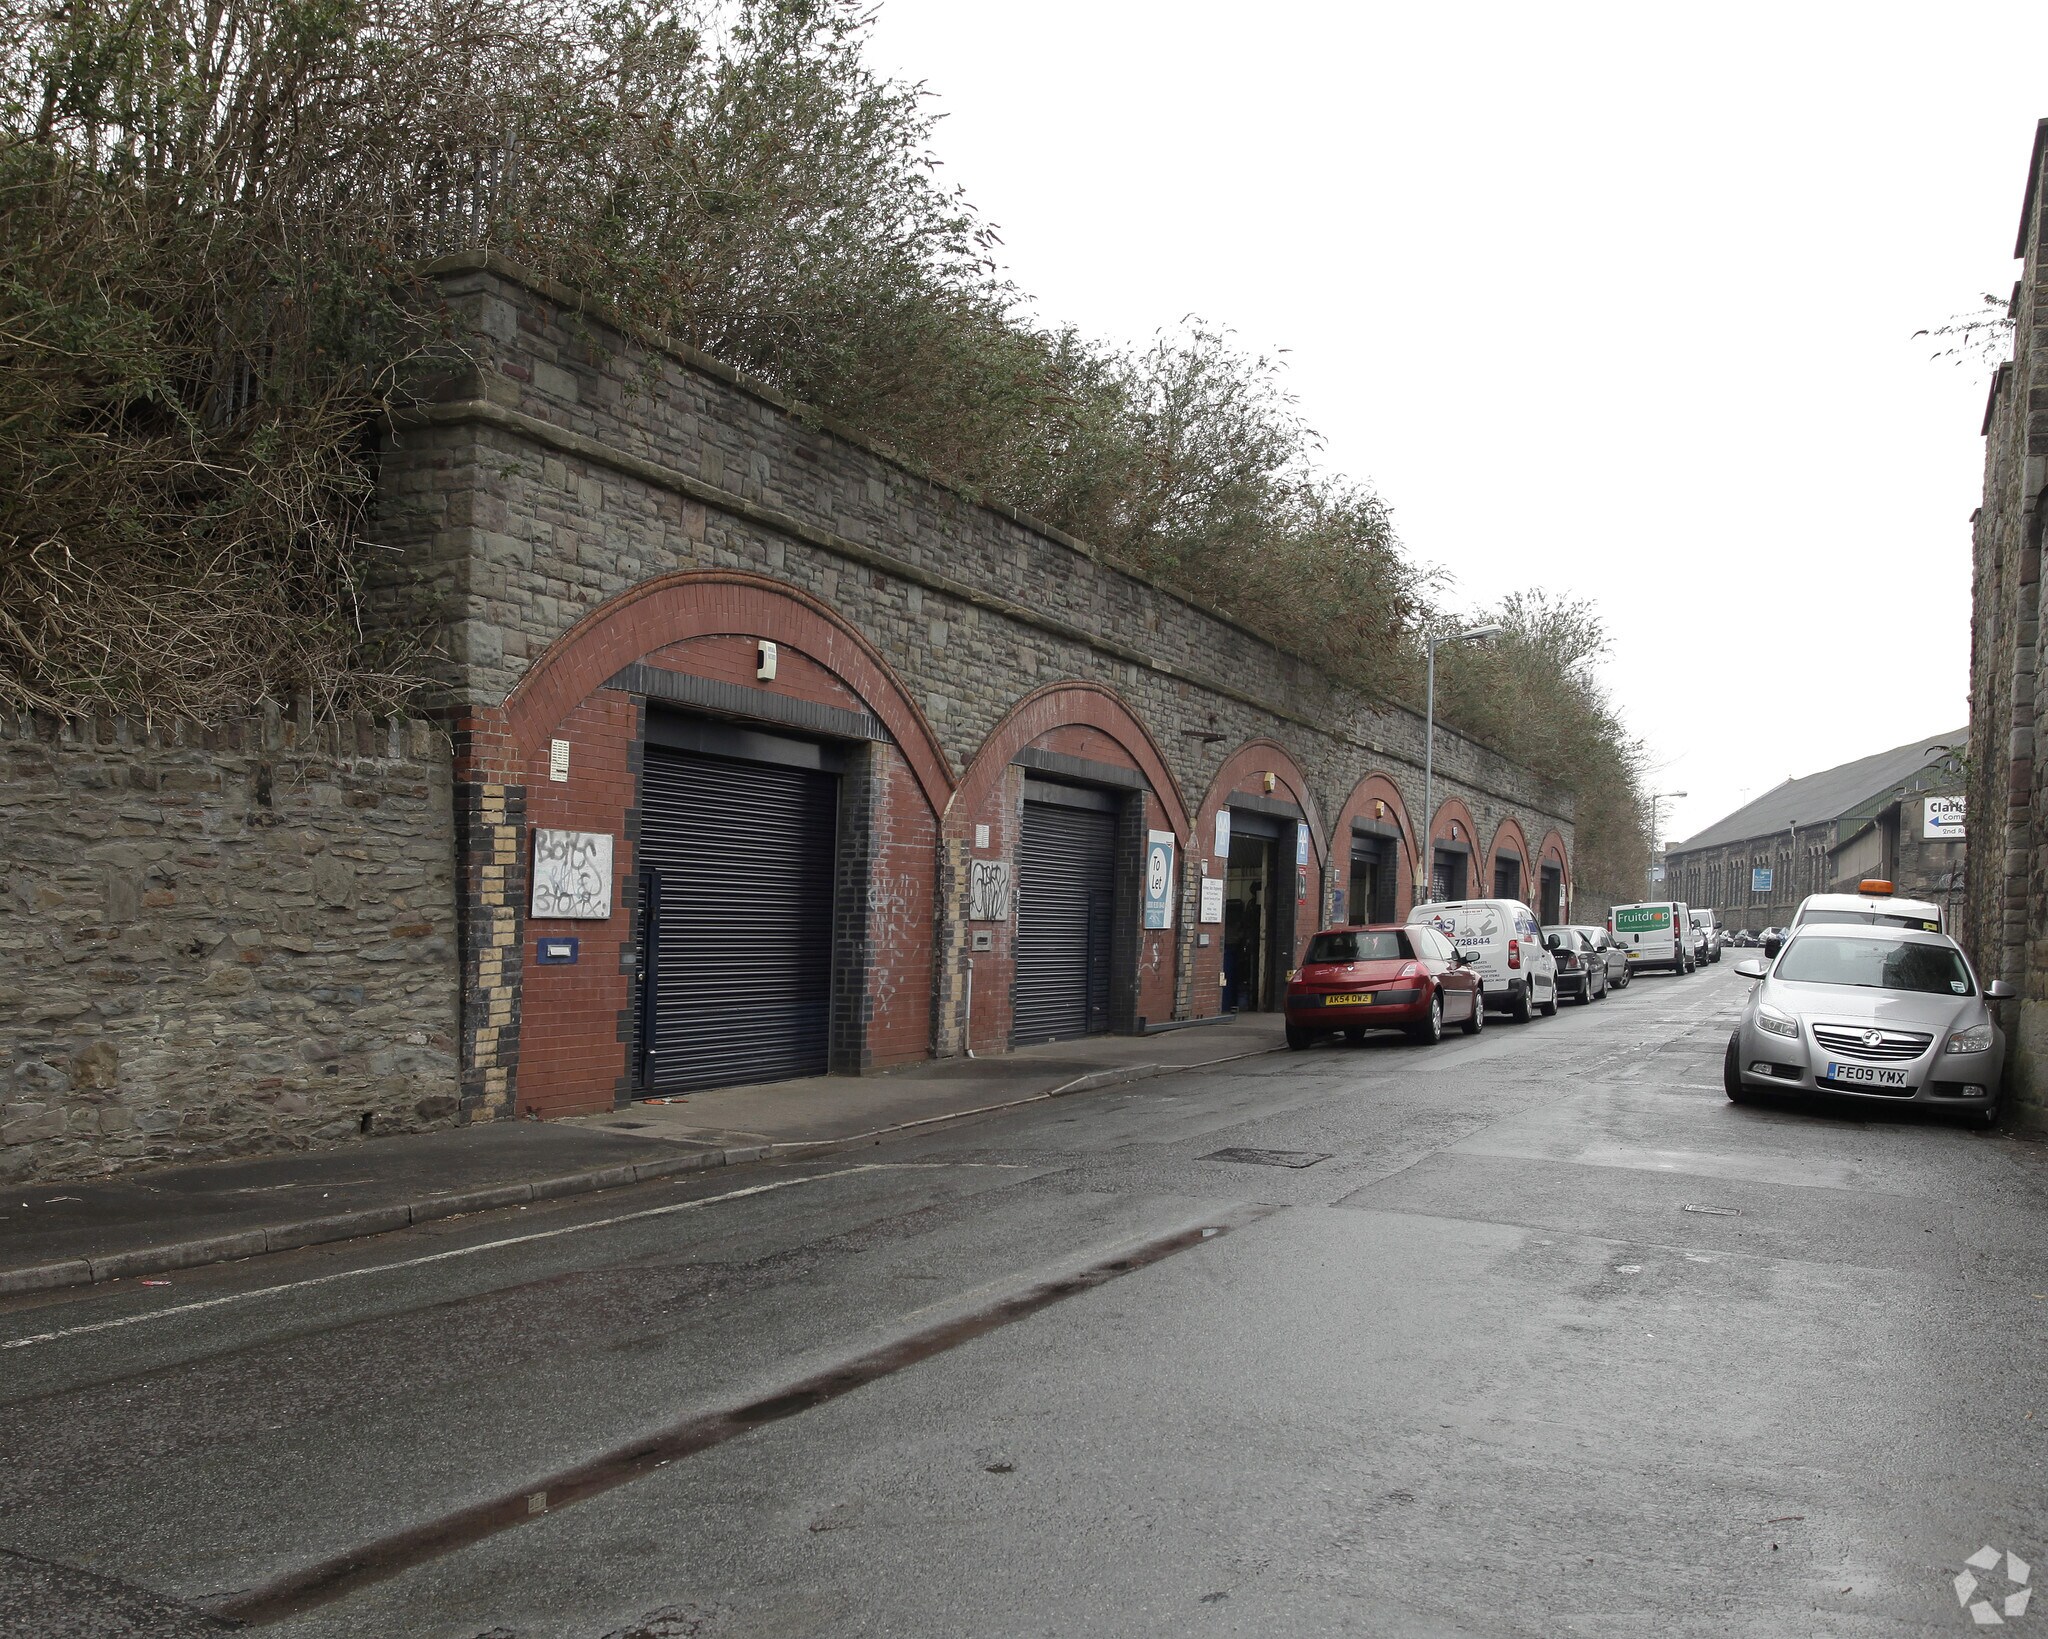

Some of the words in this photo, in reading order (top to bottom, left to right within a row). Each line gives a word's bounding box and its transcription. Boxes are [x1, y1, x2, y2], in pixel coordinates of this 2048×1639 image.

[1153, 856, 1160, 871] To
[1152, 875, 1162, 889] Let
[1618, 911, 1669, 923] Fruitdrop
[1455, 937, 1490, 946] 728844
[1329, 995, 1349, 1004] AK54
[1837, 1066, 1873, 1081] FE09
[1878, 1070, 1905, 1085] YMX
